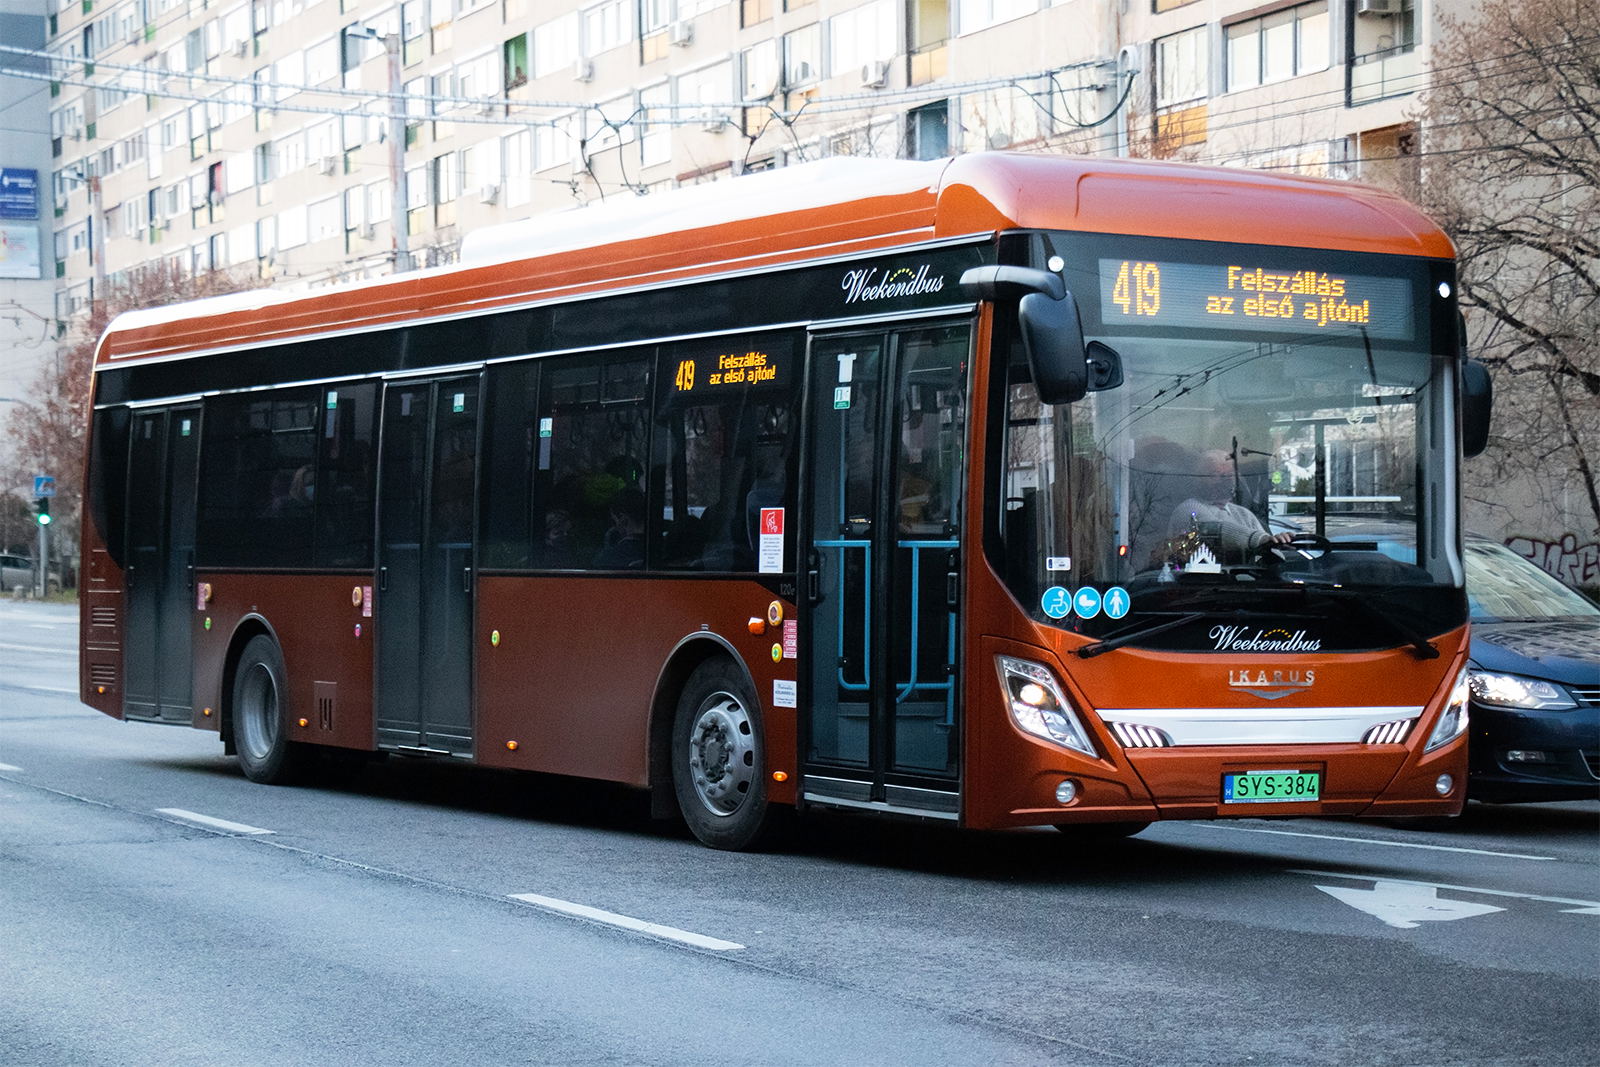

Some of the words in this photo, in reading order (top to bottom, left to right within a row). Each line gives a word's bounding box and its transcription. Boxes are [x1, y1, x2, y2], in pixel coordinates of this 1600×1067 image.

[841, 264, 944, 304] Weekendbus
[1113, 261, 1160, 316] 419
[1228, 265, 1346, 297] Felszállás
[1206, 295, 1235, 315] az
[1243, 293, 1295, 319] első
[1303, 297, 1369, 327] ajtón!
[719, 352, 768, 369] Felszállás
[676, 360, 695, 391] 419
[709, 373, 722, 385] az
[747, 365, 776, 385] ajtón!
[1209, 625, 1321, 651] Weekendbus
[1228, 670, 1315, 684] IKARUS
[1237, 776, 1316, 796] SYS-384
